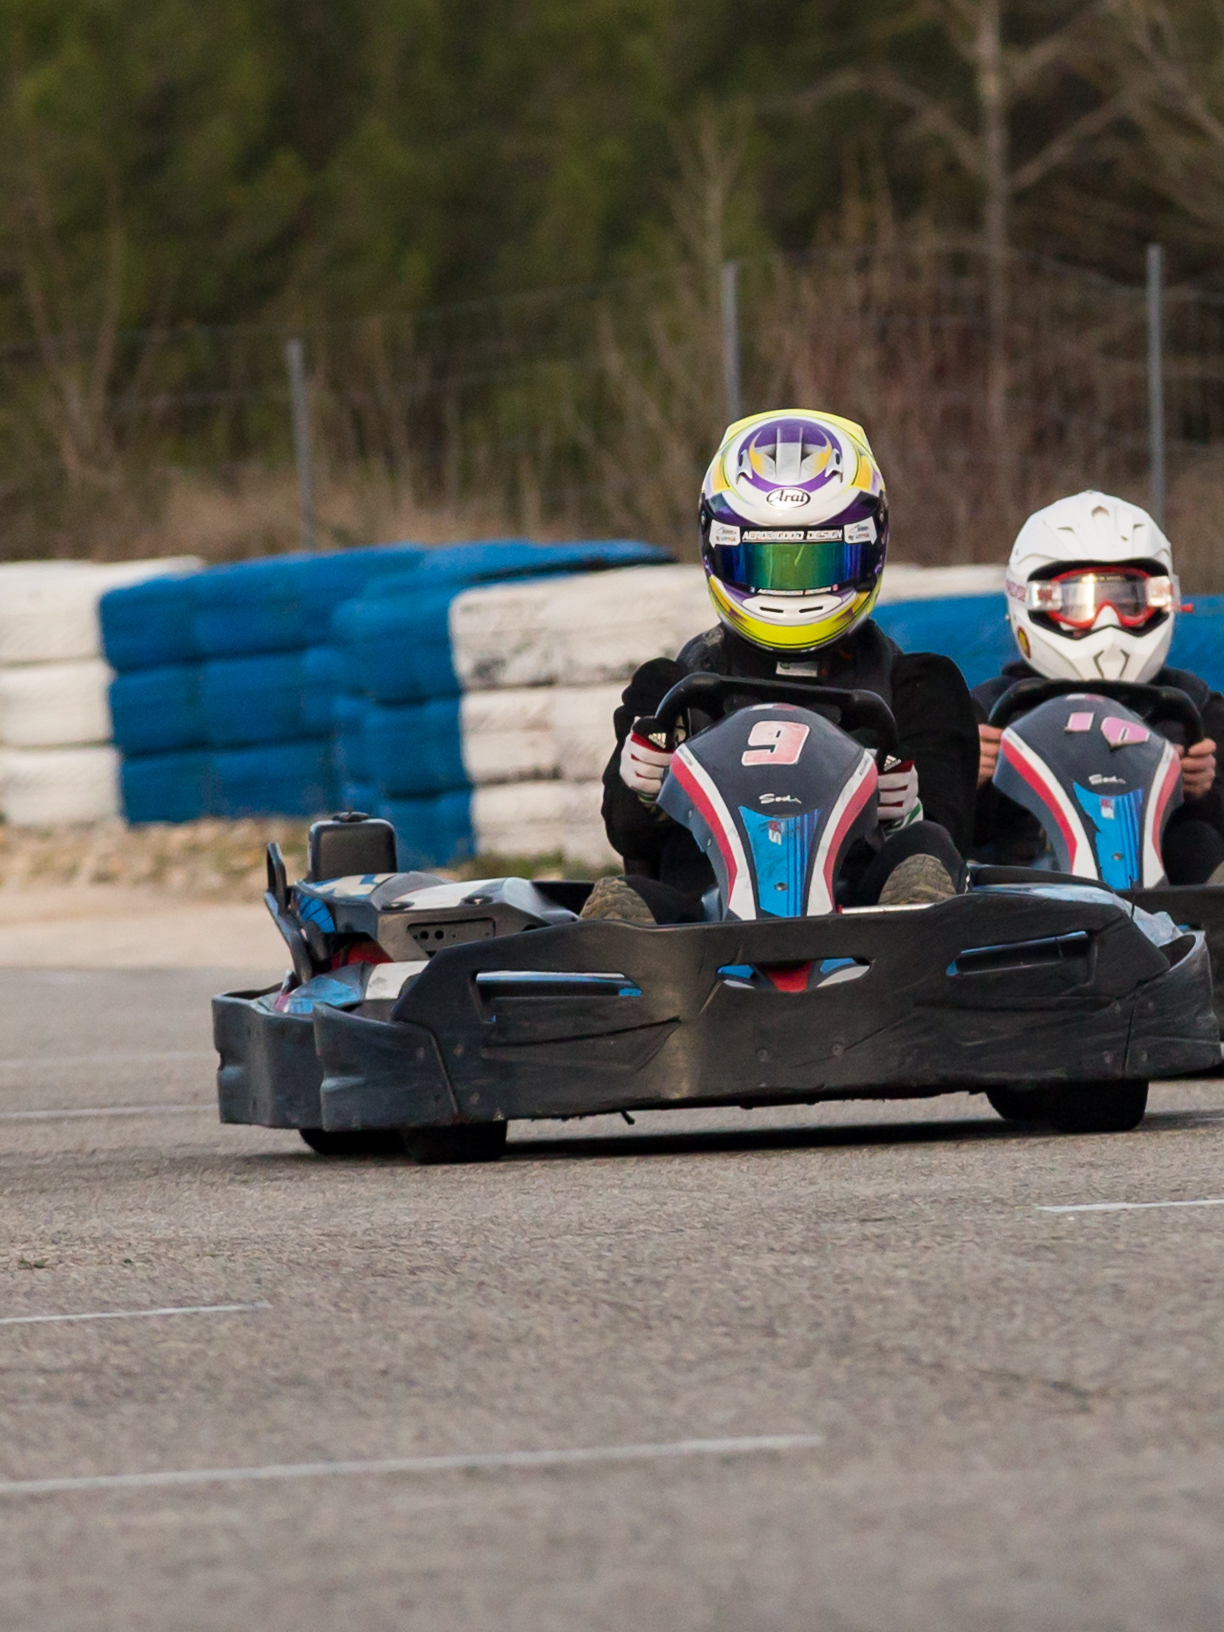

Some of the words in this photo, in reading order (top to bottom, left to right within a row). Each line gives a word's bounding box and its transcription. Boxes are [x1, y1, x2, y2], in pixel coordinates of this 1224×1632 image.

[769, 489, 804, 502] Arai
[807, 530, 842, 540] DESIGN
[741, 720, 810, 766] 9
